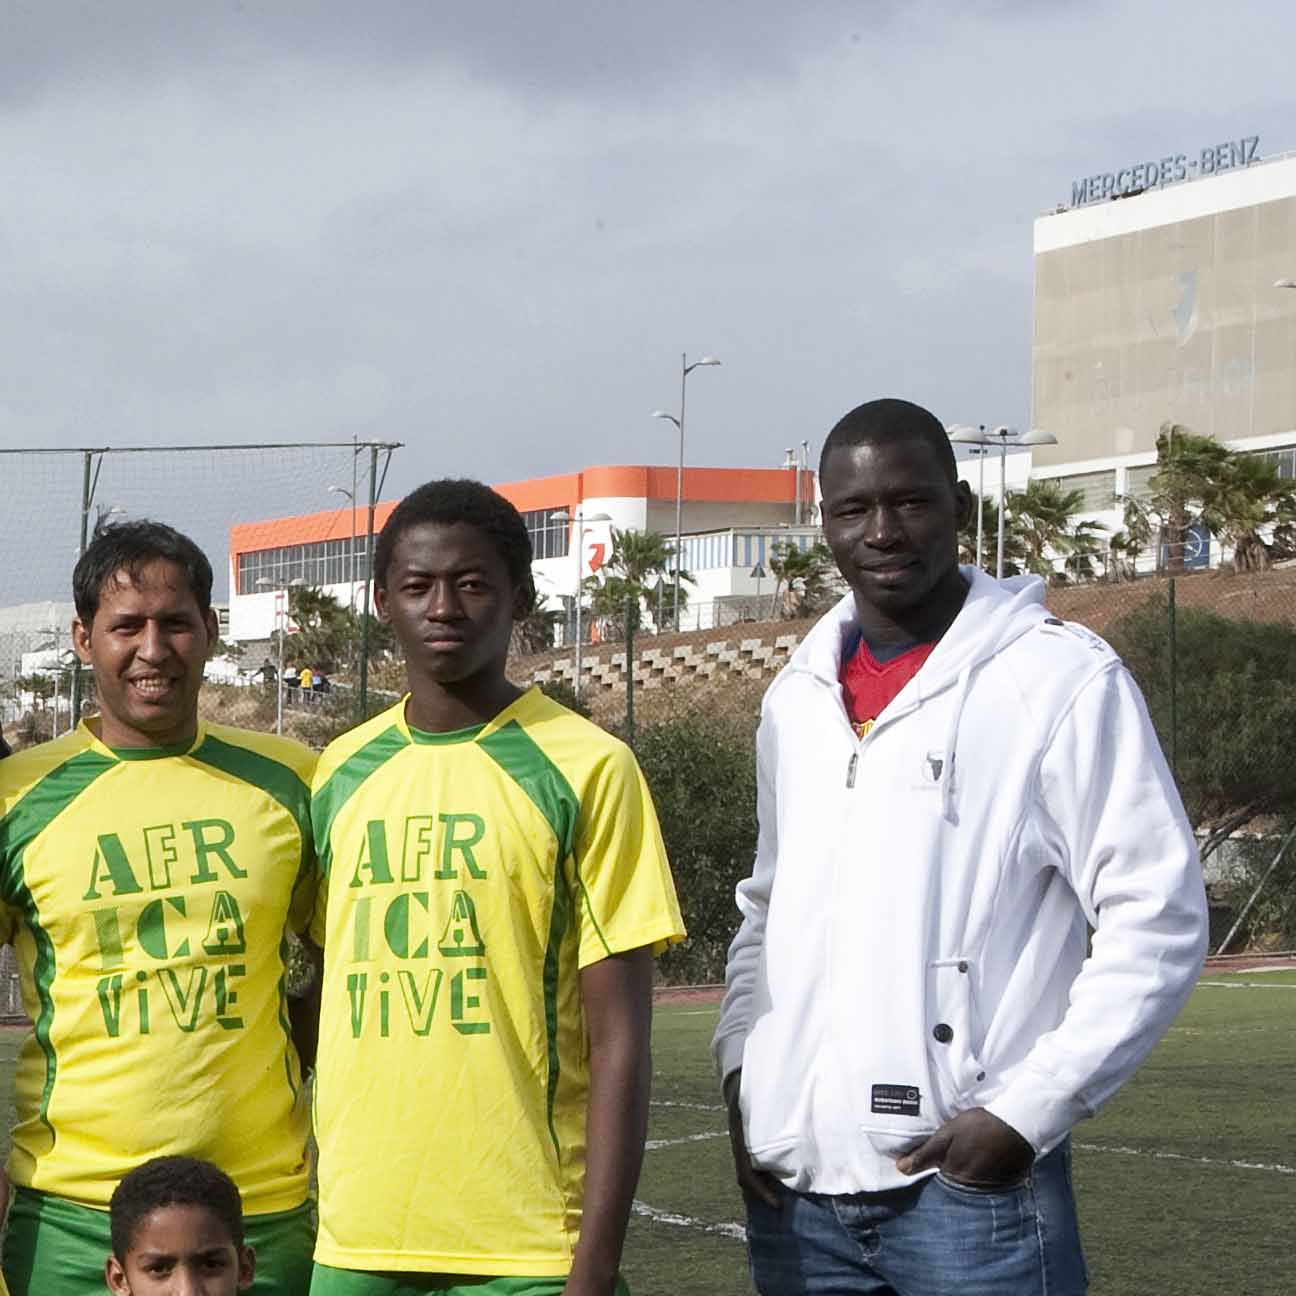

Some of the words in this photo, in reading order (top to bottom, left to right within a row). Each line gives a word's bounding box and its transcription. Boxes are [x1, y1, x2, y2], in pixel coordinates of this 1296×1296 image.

[1071, 136, 1261, 207] MERCEDES-BENZ
[83, 816, 247, 900] AFR
[349, 812, 487, 889] AFR
[90, 889, 246, 969] ICA
[350, 890, 485, 963] ICA
